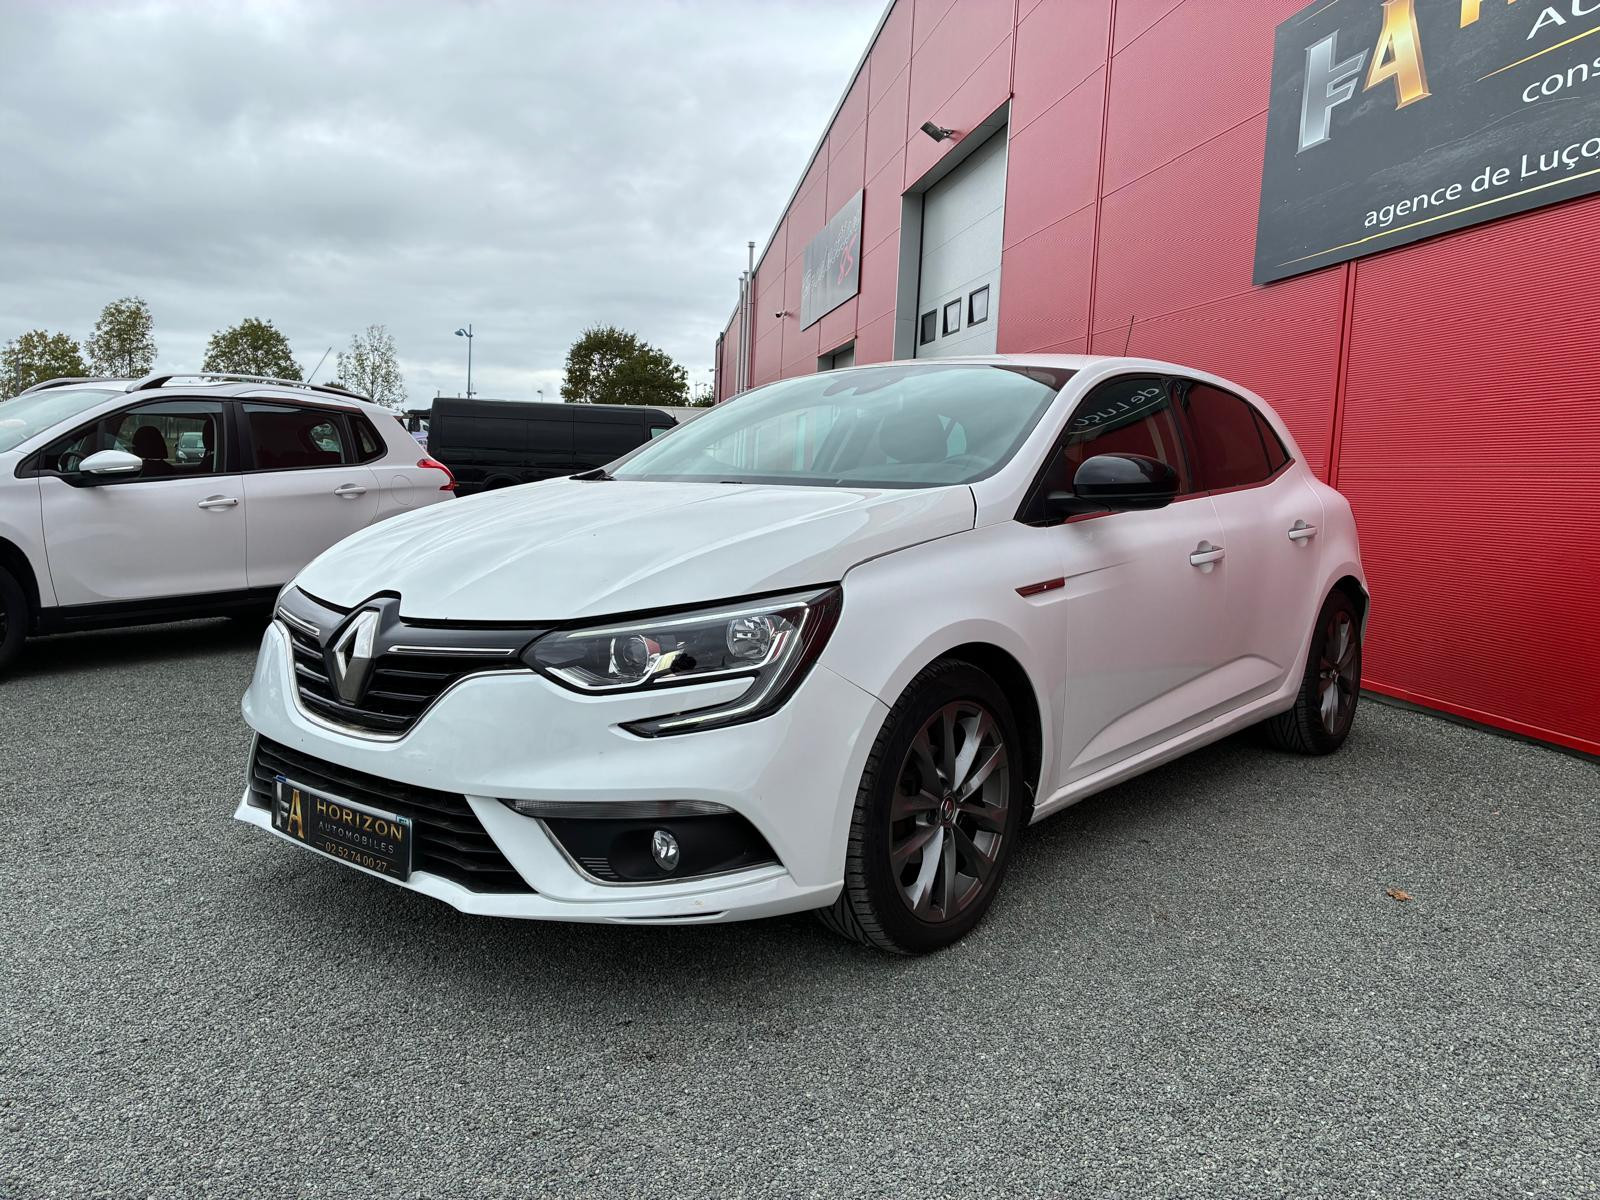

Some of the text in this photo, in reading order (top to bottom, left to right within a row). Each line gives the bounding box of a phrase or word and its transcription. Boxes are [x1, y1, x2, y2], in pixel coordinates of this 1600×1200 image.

[1364, 183, 1463, 228] agence
[1470, 166, 1511, 193] de
[316, 798, 403, 842] HORIZON
[318, 821, 394, 854] AUTOMOBILES
[325, 841, 387, 873] 02 52 74 00 27
